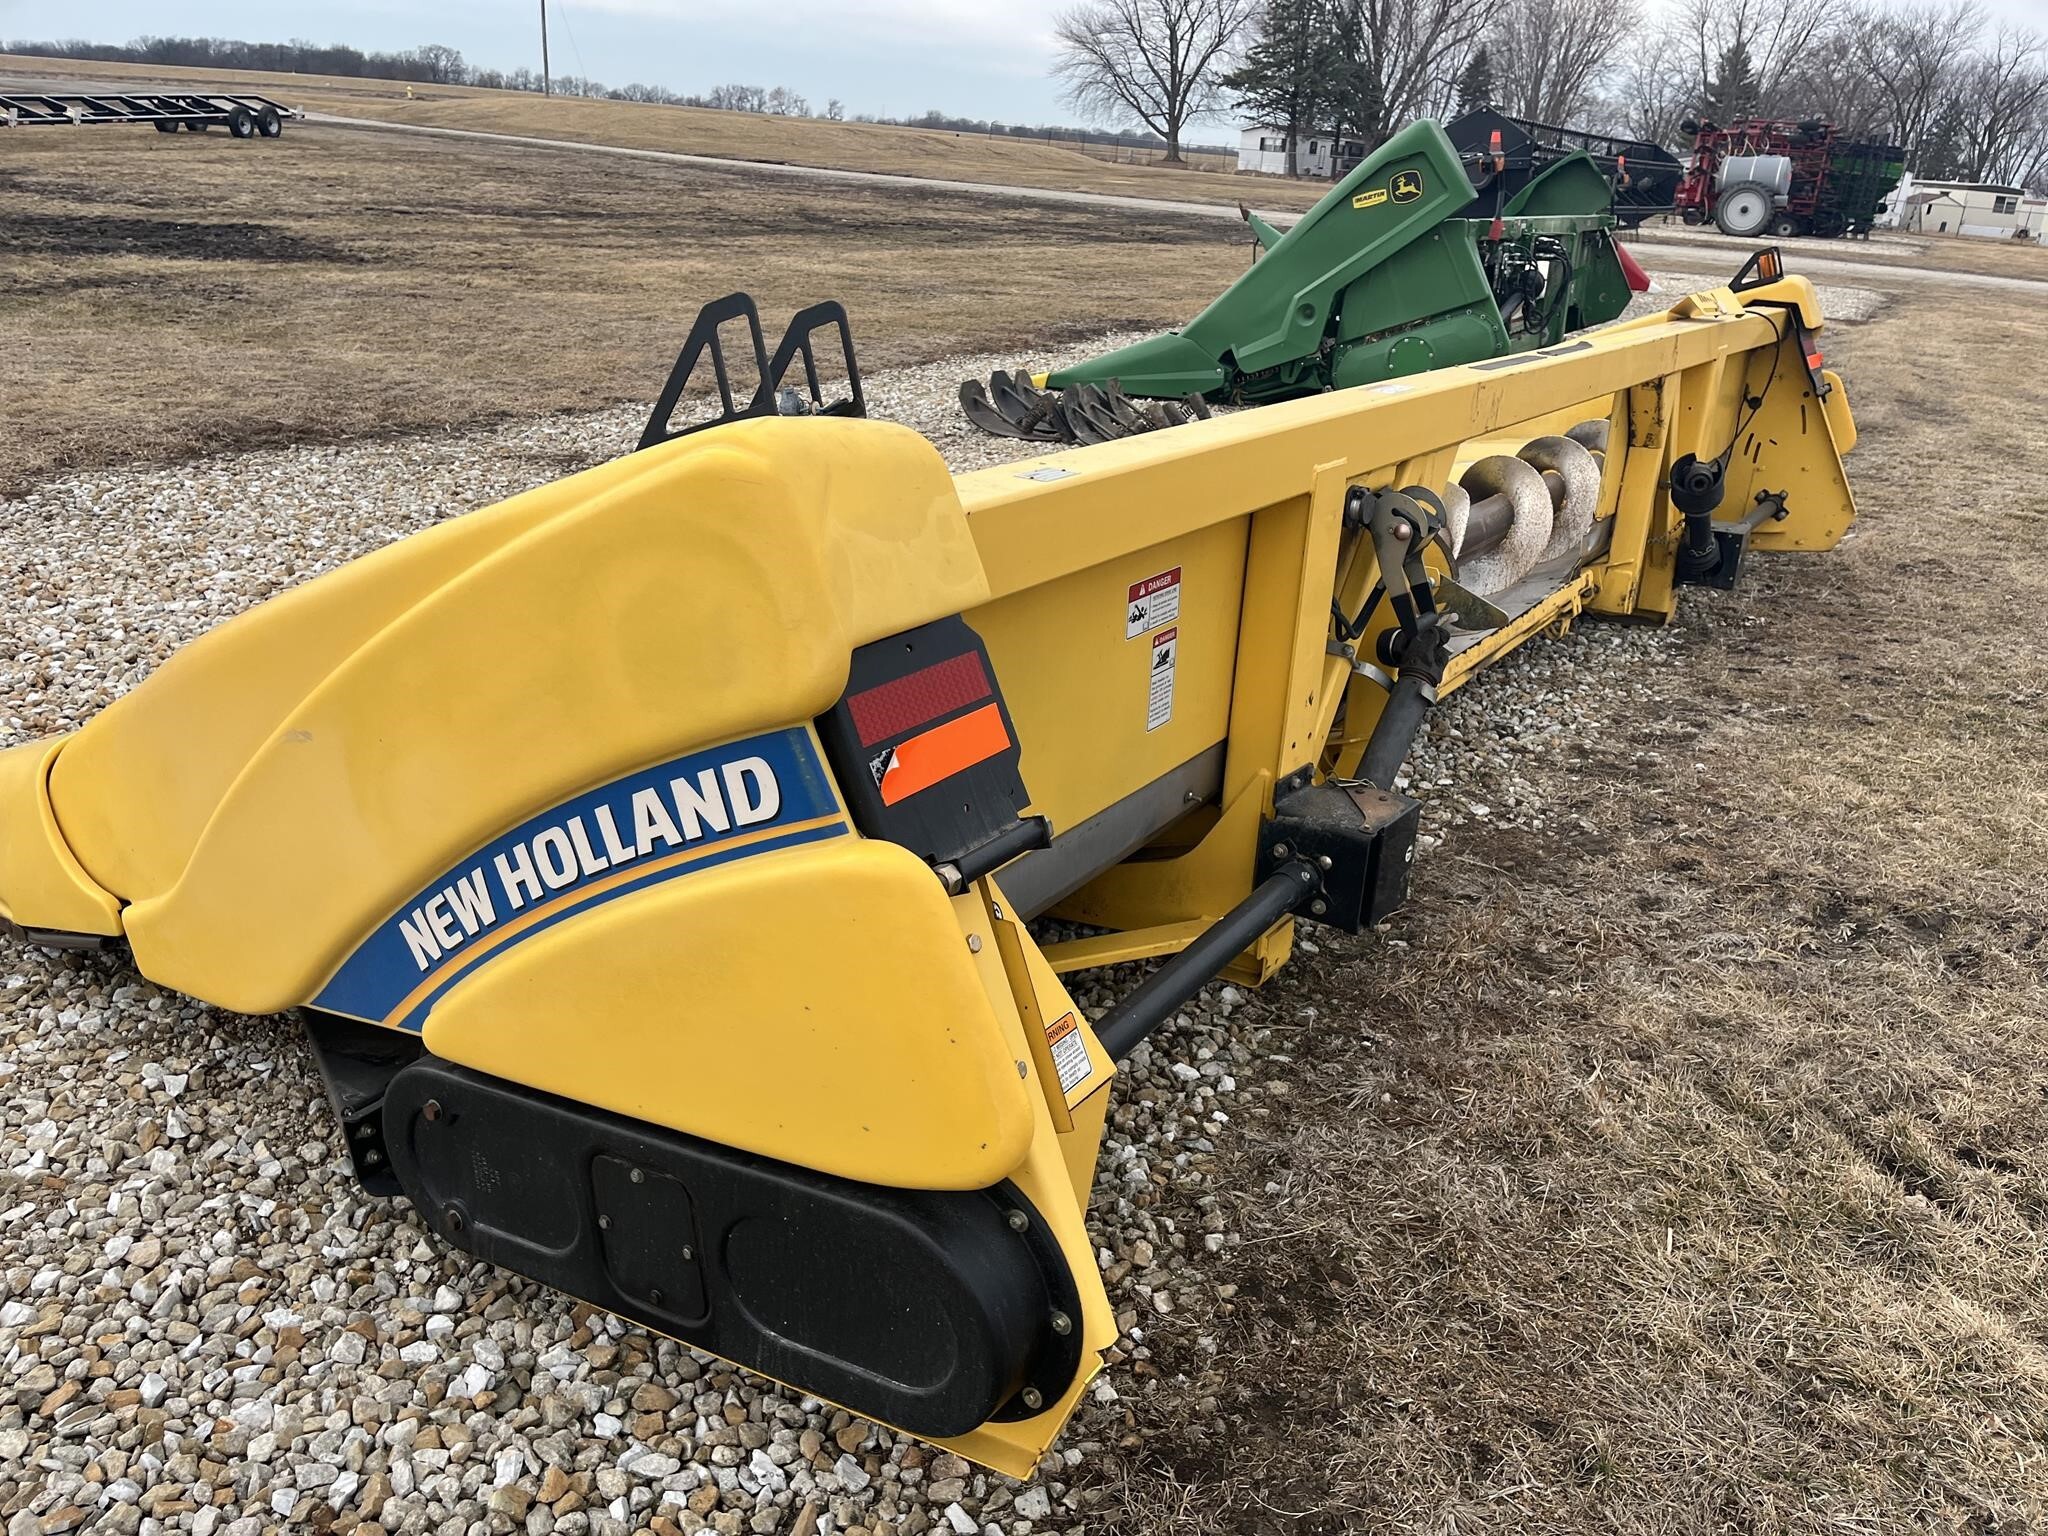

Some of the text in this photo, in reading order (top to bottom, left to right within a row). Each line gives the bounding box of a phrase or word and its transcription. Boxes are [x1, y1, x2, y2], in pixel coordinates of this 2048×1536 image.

[1354, 191, 1386, 203] MARTIN
[1148, 575, 1172, 592] DANGER
[1159, 631, 1176, 643] DANGER
[398, 756, 781, 972] NEW HOLLAND
[1047, 1020, 1070, 1041] RNING
